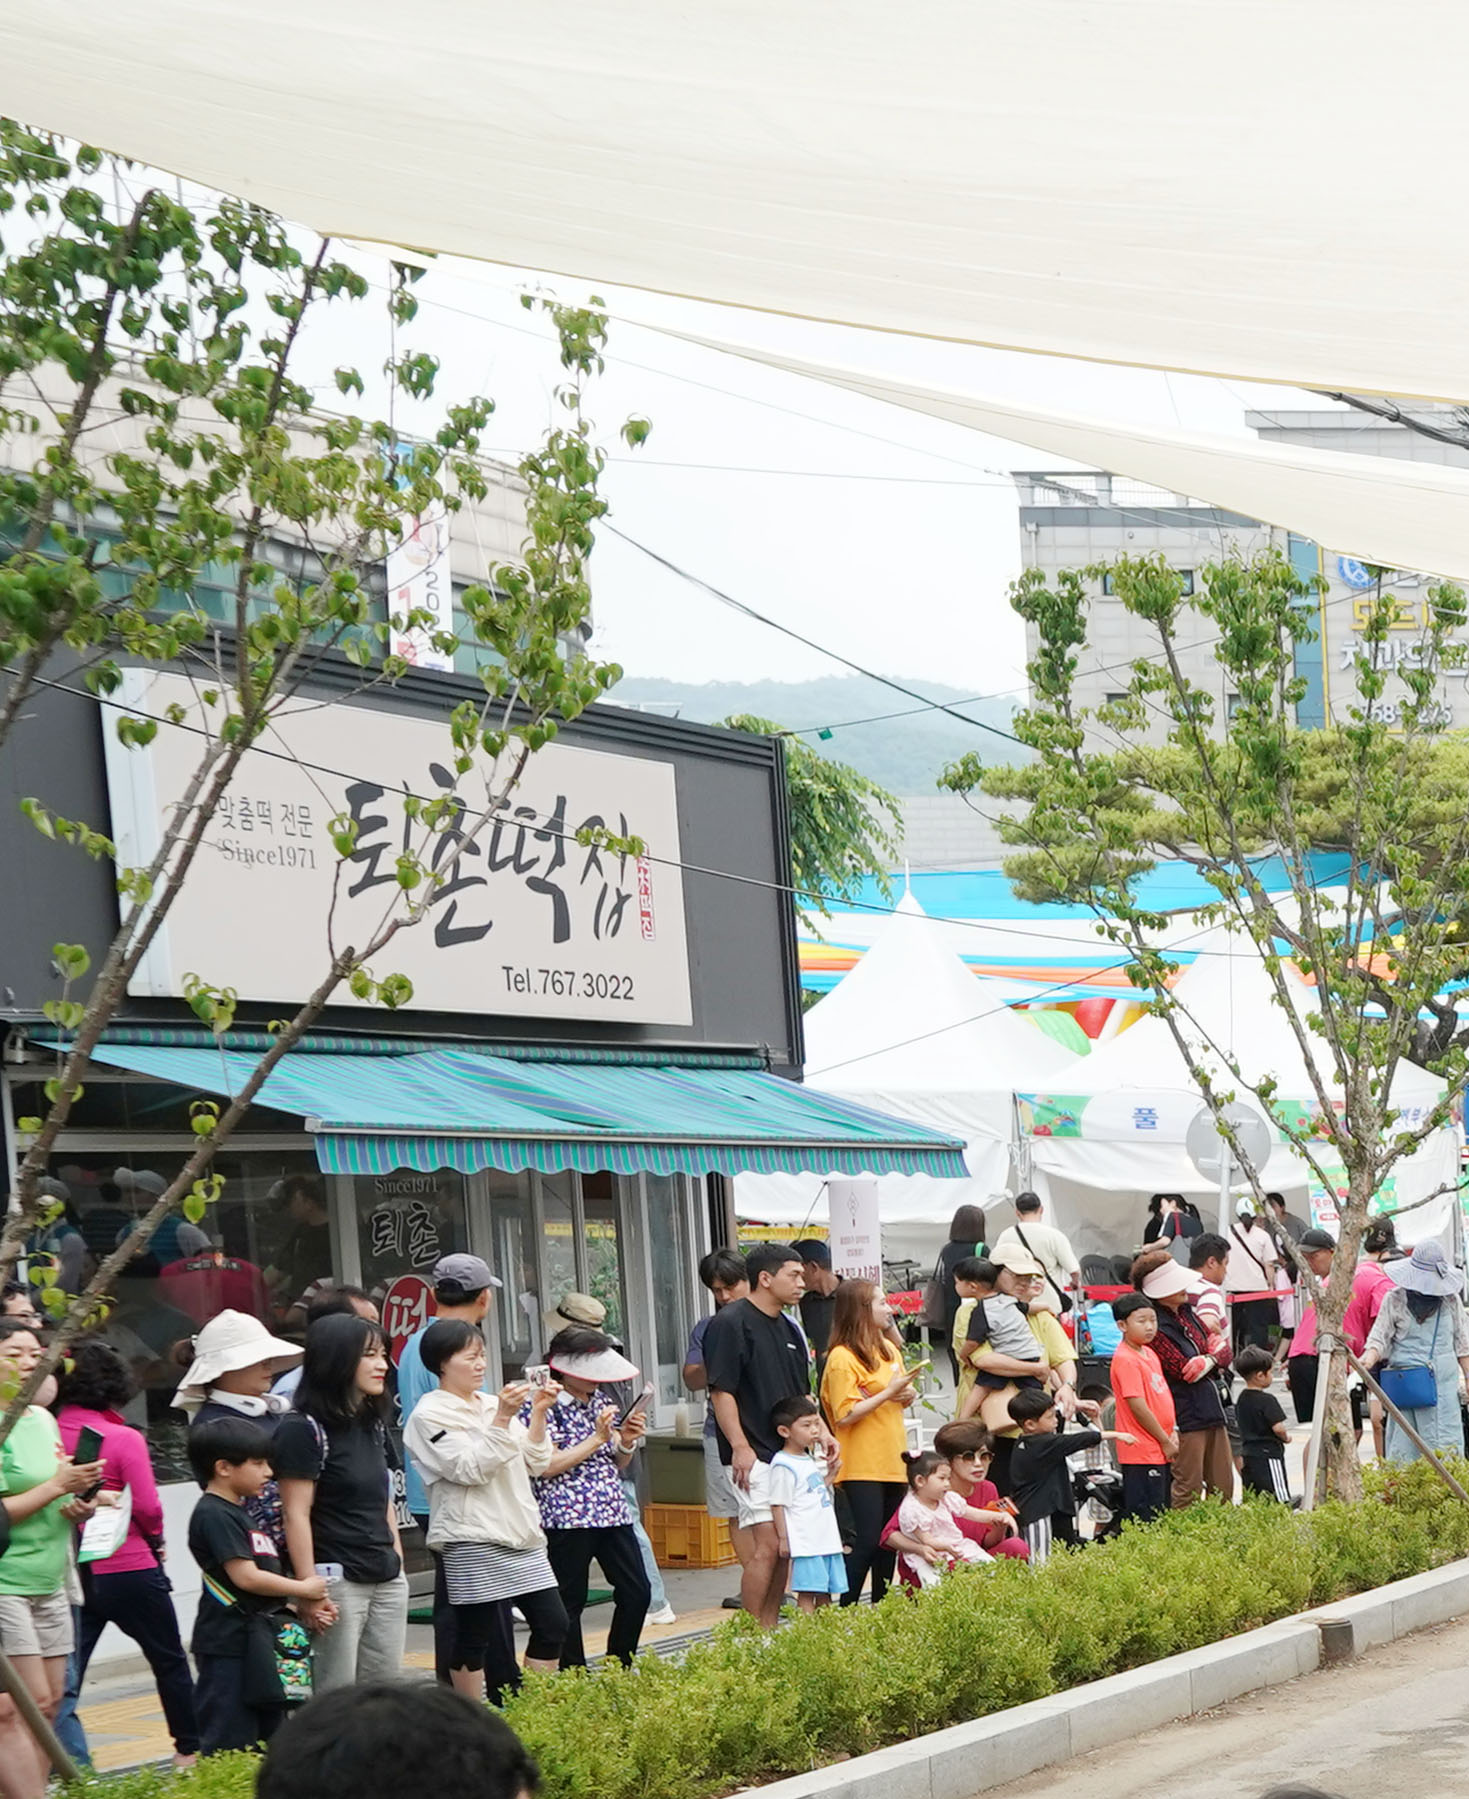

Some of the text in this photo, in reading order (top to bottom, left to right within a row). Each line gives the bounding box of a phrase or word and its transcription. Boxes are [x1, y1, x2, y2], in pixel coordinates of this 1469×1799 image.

[218, 795, 313, 839] 맞춤떡 전문
[221, 838, 317, 870] Since1971
[345, 761, 633, 949] 퇴촌떡집
[501, 965, 635, 1001] Tel.767.3022
[374, 1176, 439, 1194] Since1971
[371, 1200, 442, 1268] 퇴촌
